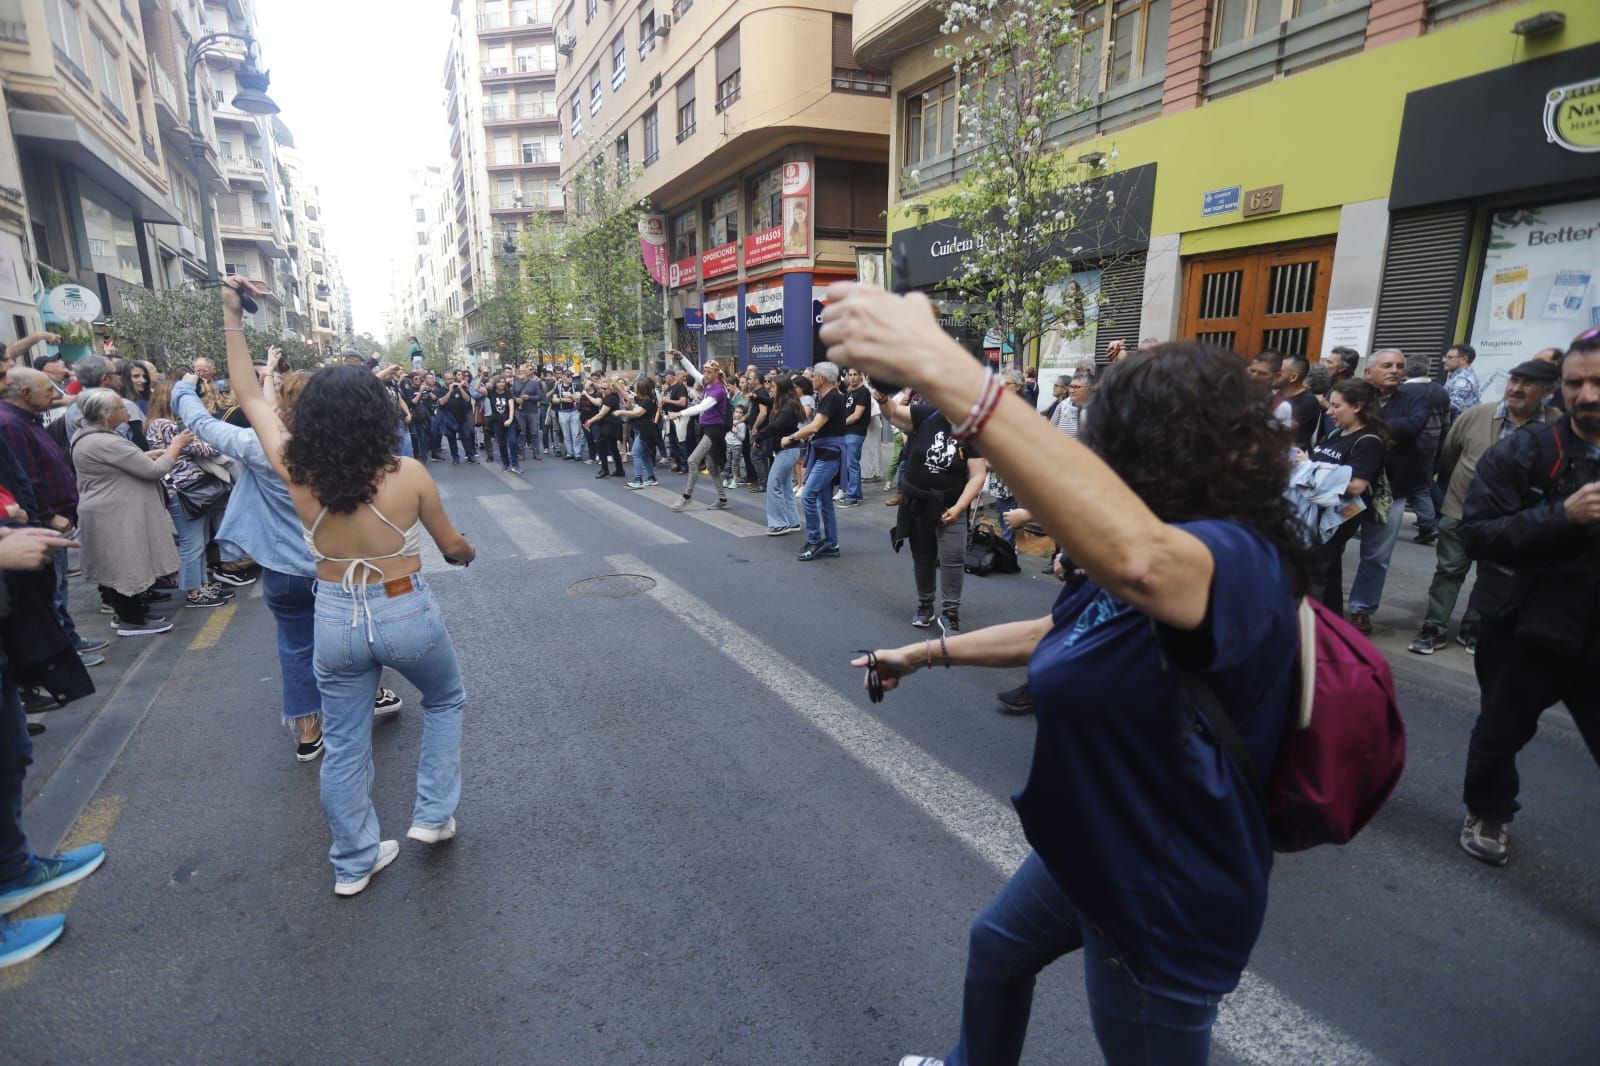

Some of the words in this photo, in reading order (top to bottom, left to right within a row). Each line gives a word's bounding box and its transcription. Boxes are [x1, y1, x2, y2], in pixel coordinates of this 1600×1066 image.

[1250, 190, 1273, 210] 63
[755, 229, 781, 245] REPASOS
[702, 246, 737, 263] OPOSICIONES
[931, 236, 973, 257] Cuidem
[707, 320, 735, 332] dormitienda
[747, 313, 782, 327] dormitienda
[1480, 340, 1522, 349] Magnesio
